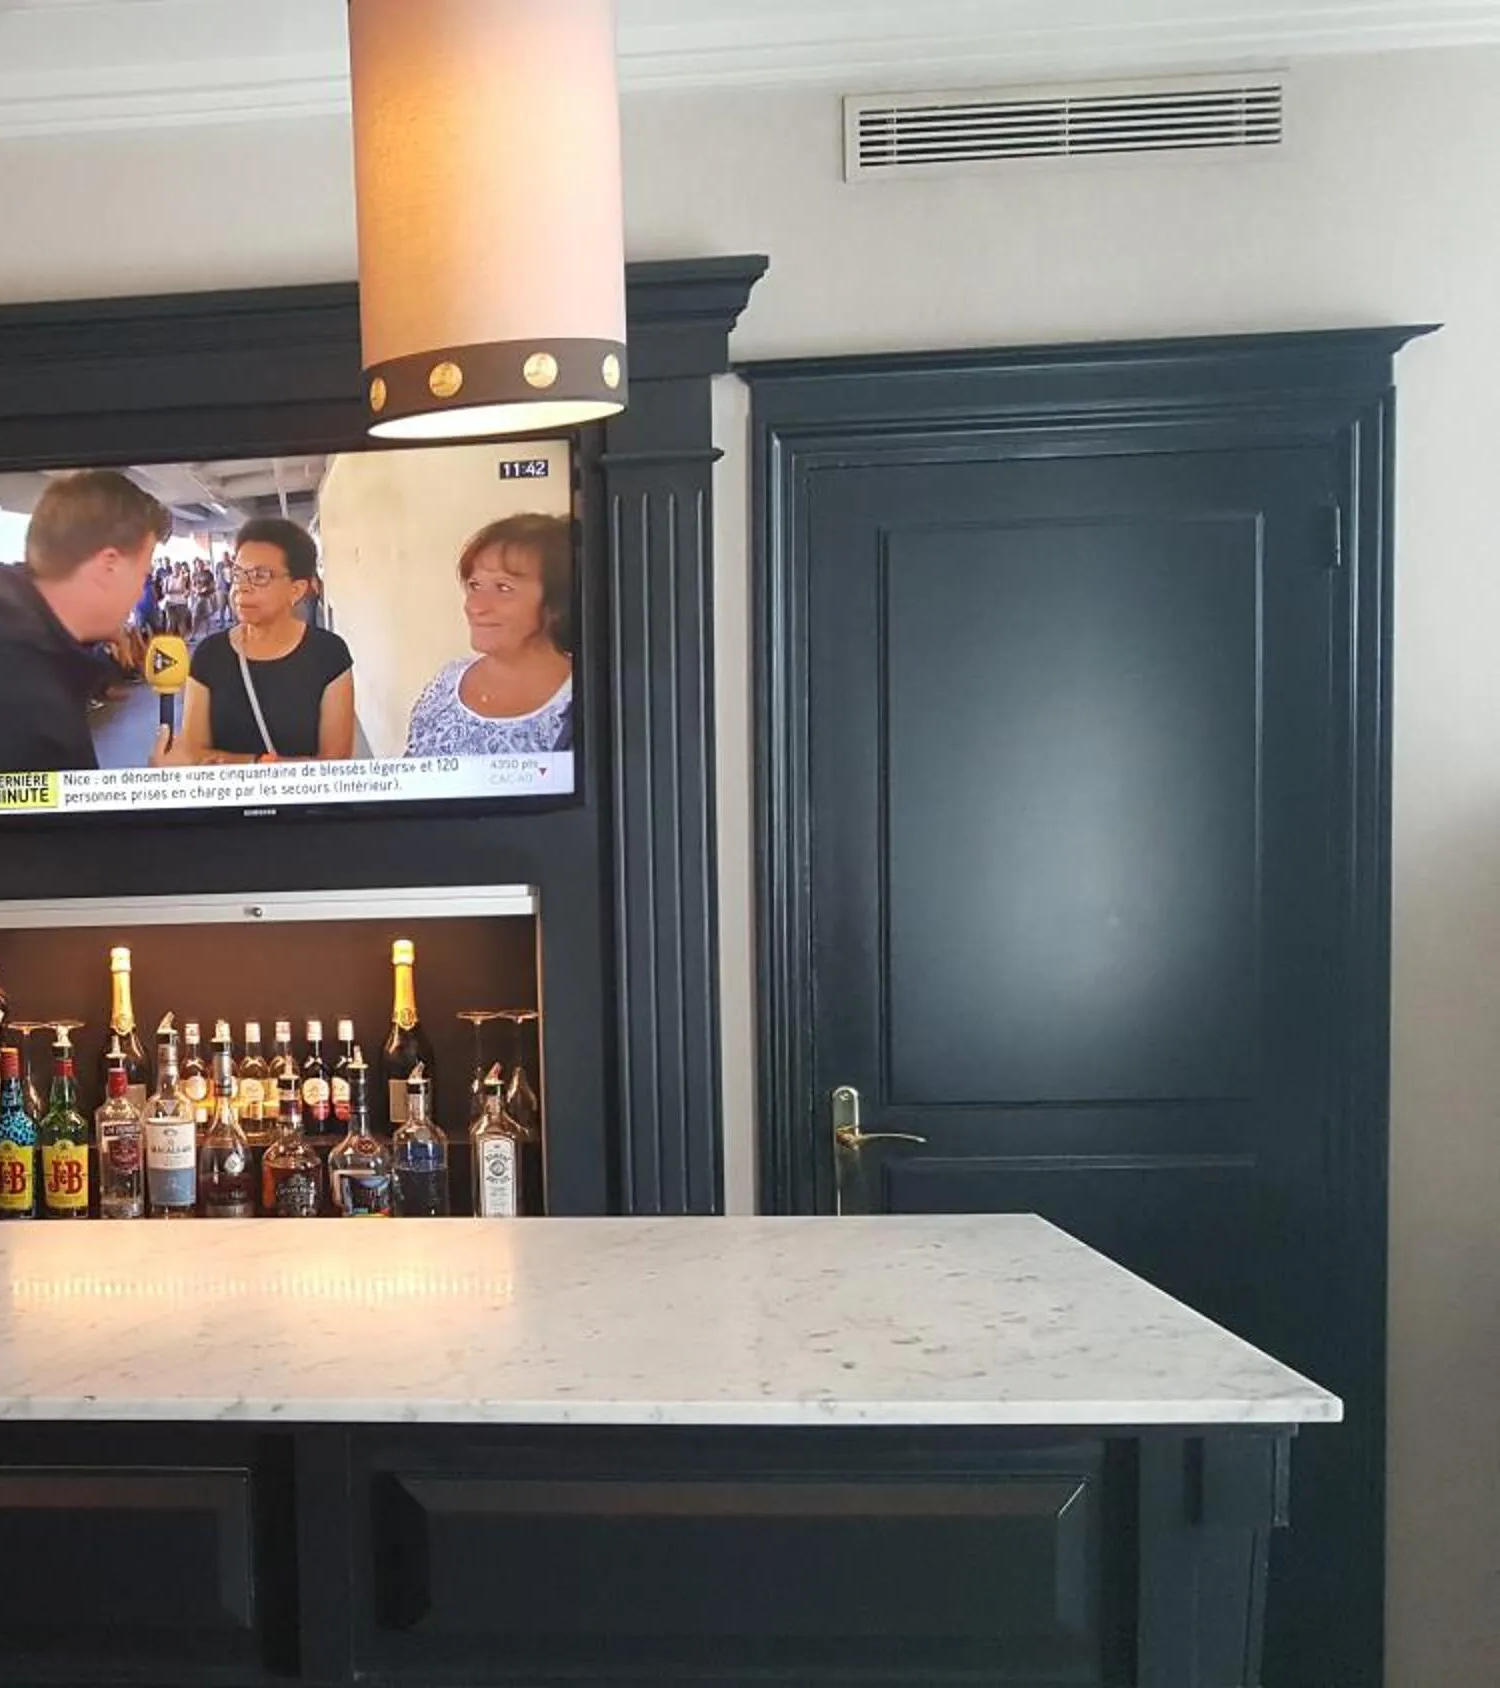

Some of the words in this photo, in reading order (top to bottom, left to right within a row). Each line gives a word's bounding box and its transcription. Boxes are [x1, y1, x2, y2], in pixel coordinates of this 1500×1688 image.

[503, 461, 546, 476] 11:42
[63, 774, 91, 786] Nice
[103, 775, 117, 785] on
[219, 766, 297, 782] cinquantaine
[301, 763, 316, 776] de
[420, 759, 434, 772] et
[436, 757, 460, 773] 120
[64, 790, 126, 806] personnes
[131, 788, 168, 803] prises
[171, 788, 187, 799] en
[189, 785, 231, 801] charge
[235, 786, 256, 801] par
[259, 783, 277, 796] les
[281, 781, 330, 795] secours
